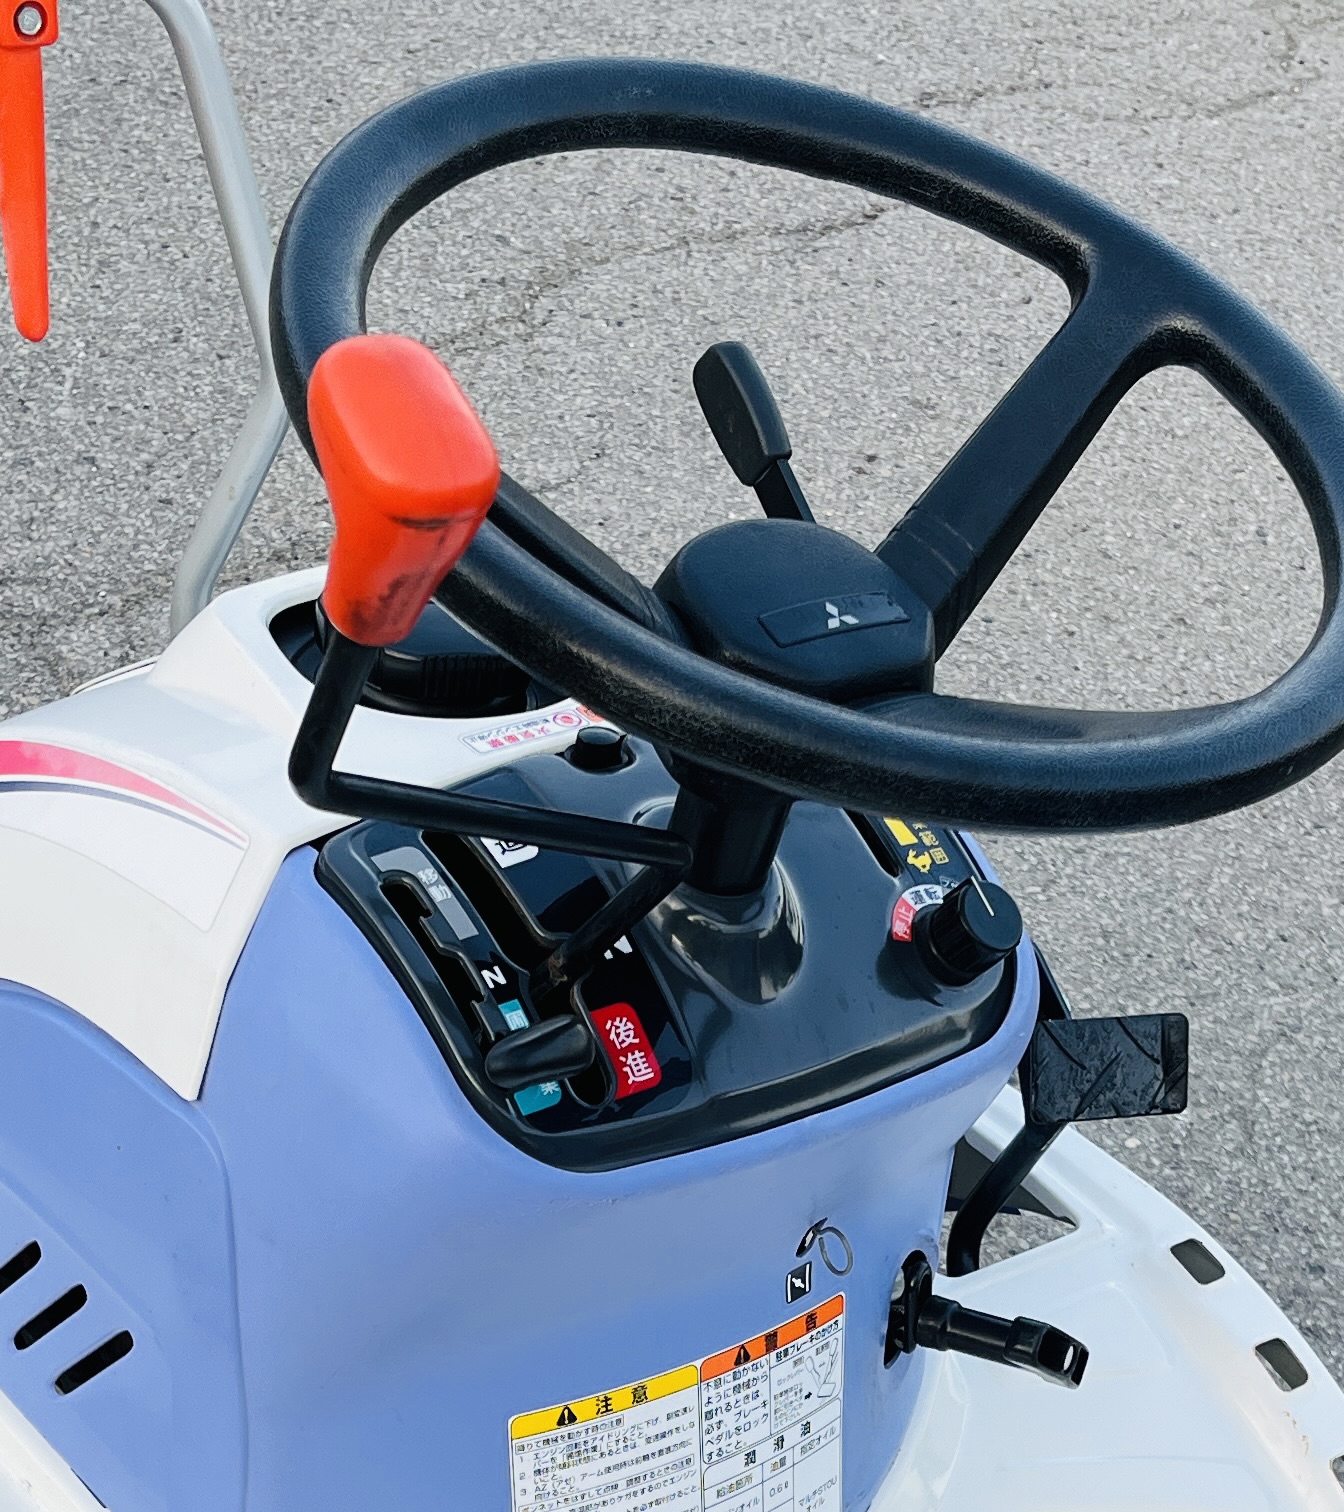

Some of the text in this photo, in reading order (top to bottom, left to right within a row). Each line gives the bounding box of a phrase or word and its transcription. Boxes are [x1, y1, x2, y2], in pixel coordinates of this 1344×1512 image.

[481, 965, 507, 989] N
[605, 1016, 654, 1085] 後進
[764, 1309, 817, 1354] 警告
[775, 1318, 839, 1363] 駐車ブレーキのかけ方
[702, 1355, 768, 1395] 不意に動かない
[703, 1369, 768, 1408] ように機械から
[594, 1383, 648, 1416] 注意
[704, 1411, 768, 1449] ペダルをロック
[705, 1434, 746, 1463] すること。
[743, 1419, 811, 1467] 潤滑油
